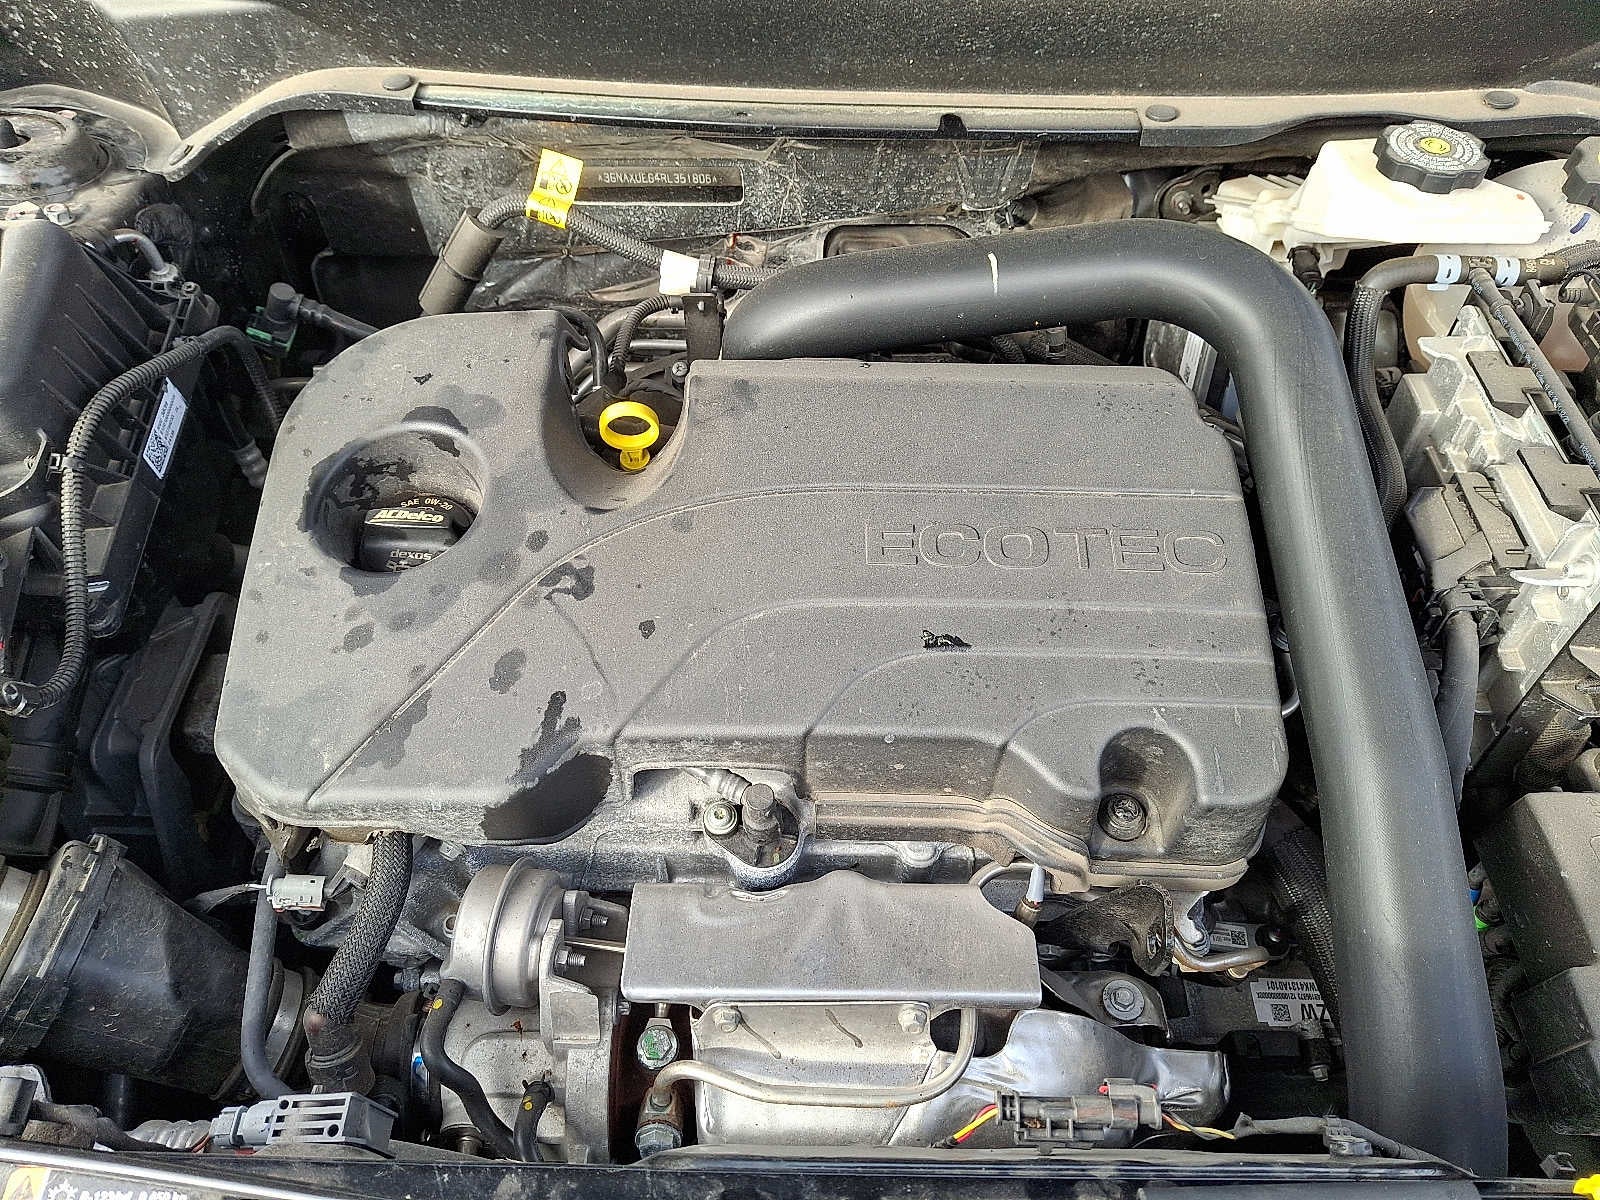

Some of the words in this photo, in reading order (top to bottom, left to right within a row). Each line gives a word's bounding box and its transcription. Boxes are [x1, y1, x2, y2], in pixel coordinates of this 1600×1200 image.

[401, 499, 420, 508] SAE
[424, 498, 453, 511] 0W-20
[372, 509, 444, 523] ACDelco
[390, 549, 432, 560] dexos
[865, 522, 1228, 575] ECOTEC
